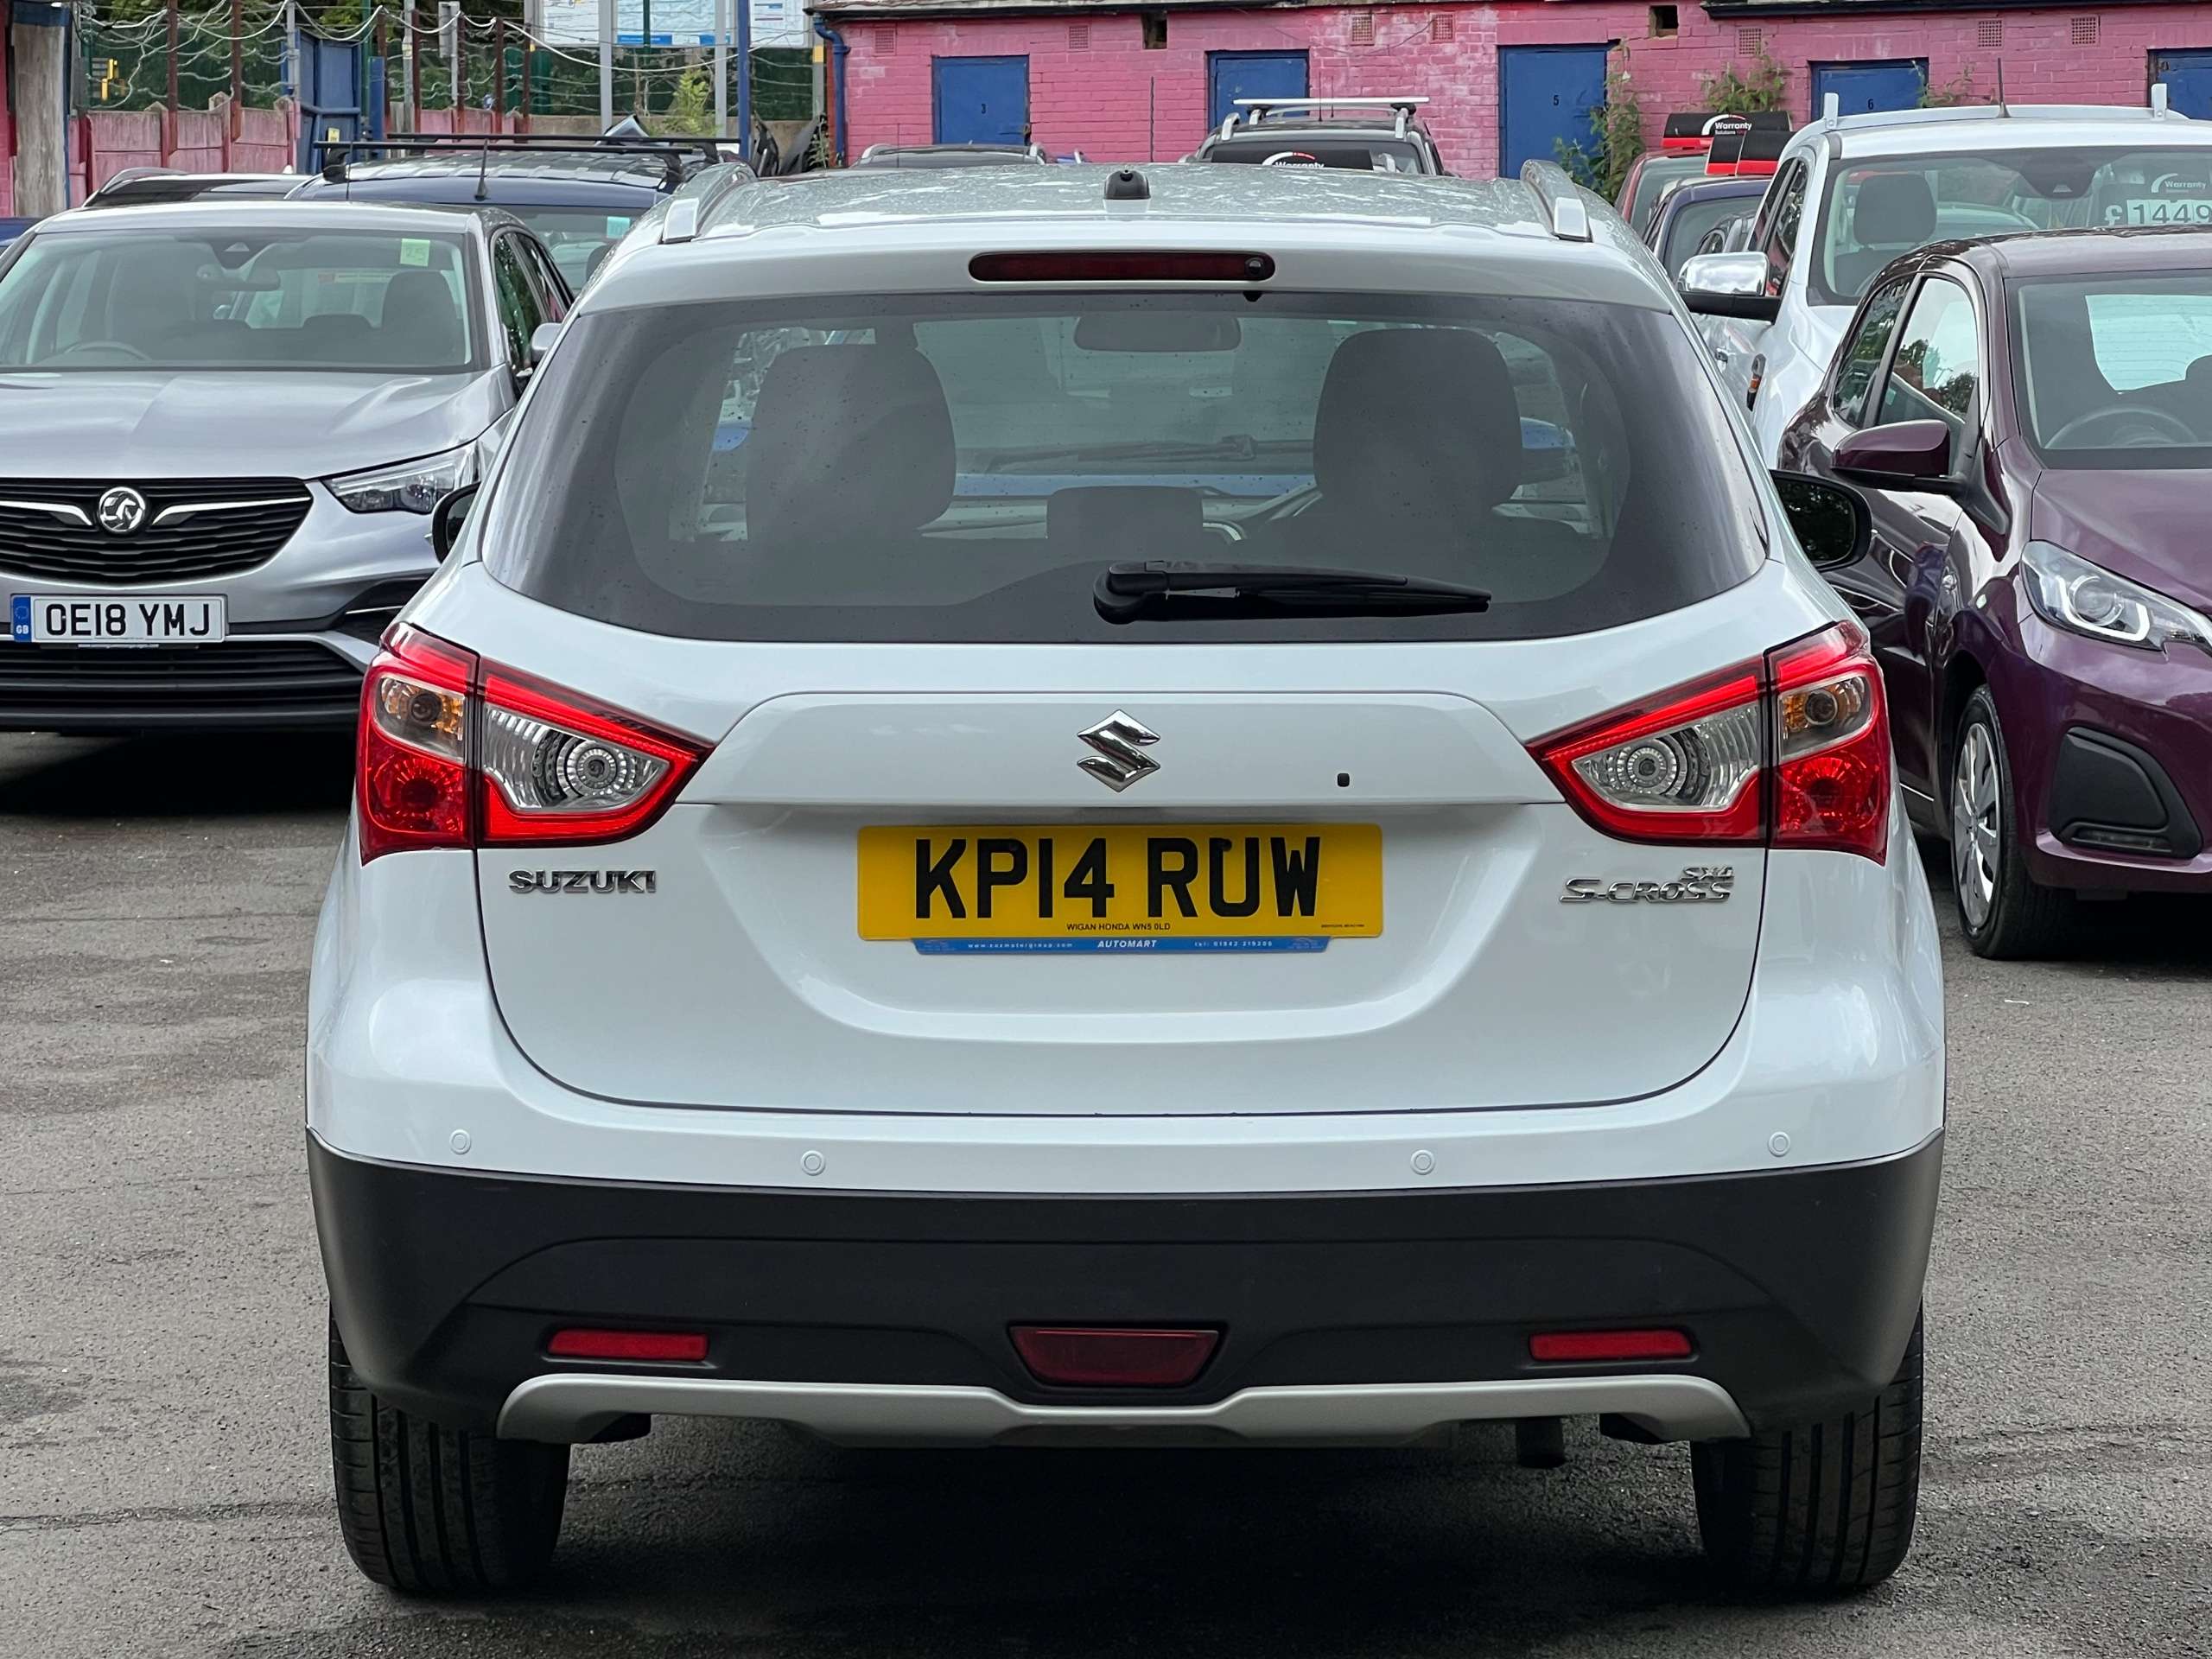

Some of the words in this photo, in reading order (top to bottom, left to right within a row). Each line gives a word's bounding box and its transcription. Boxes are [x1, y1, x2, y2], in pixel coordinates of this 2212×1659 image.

[1554, 94, 1560, 105] 5
[1867, 98, 1874, 111] 6
[981, 103, 987, 114] 3
[1715, 122, 1752, 131] Warranty
[2164, 181, 2207, 190] Warranty
[46, 603, 127, 636] OE18
[138, 603, 211, 637] YMJ
[16, 625, 29, 634] GB
[508, 869, 658, 894] SUZUKI
[916, 838, 1115, 918] KP14
[1147, 836, 1321, 918] RUW
[1559, 877, 1735, 904] S-CROSS
[1066, 923, 1096, 931] WIGAN
[1097, 939, 1157, 949] AUTOMART
